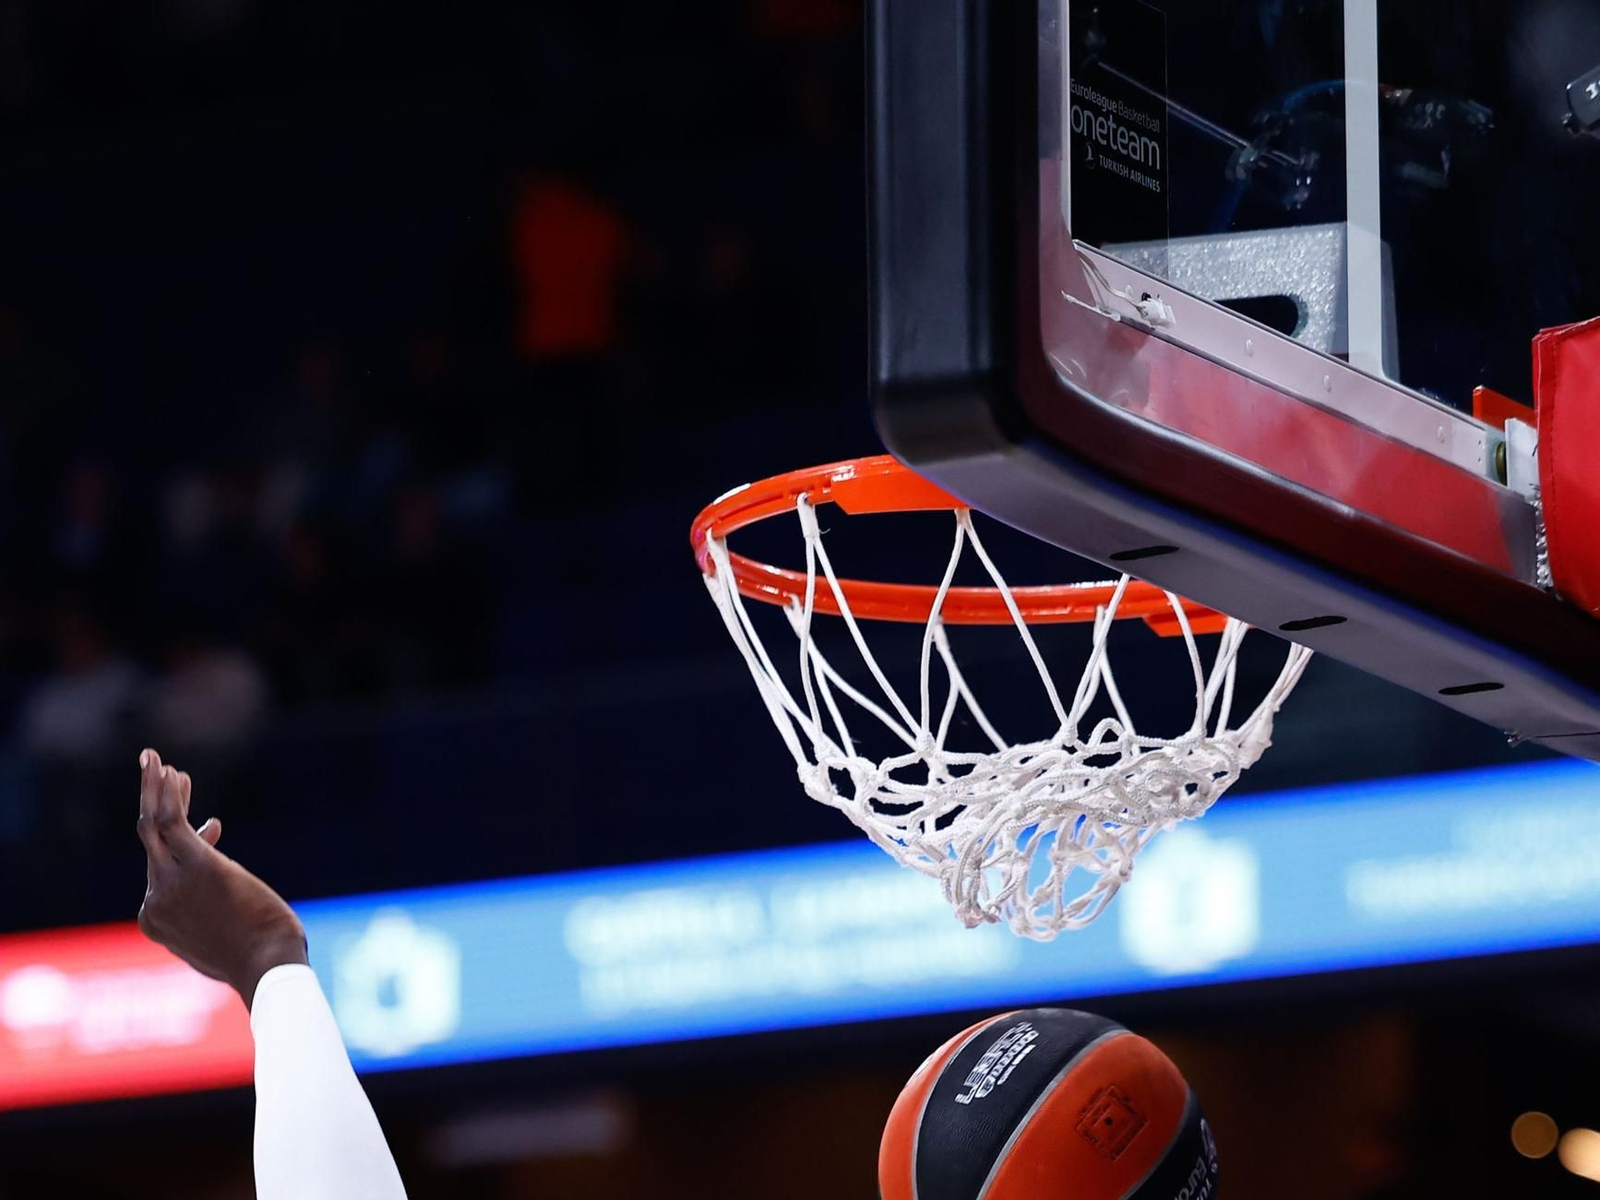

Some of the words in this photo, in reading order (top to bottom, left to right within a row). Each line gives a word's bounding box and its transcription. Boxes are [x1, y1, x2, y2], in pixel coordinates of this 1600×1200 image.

[1070, 78, 1118, 113] Euroleague
[1118, 101, 1160, 133] Basketball
[1071, 105, 1160, 170] oneteam
[1099, 155, 1129, 178] TURKISH
[1130, 169, 1160, 193] AIRLINES
